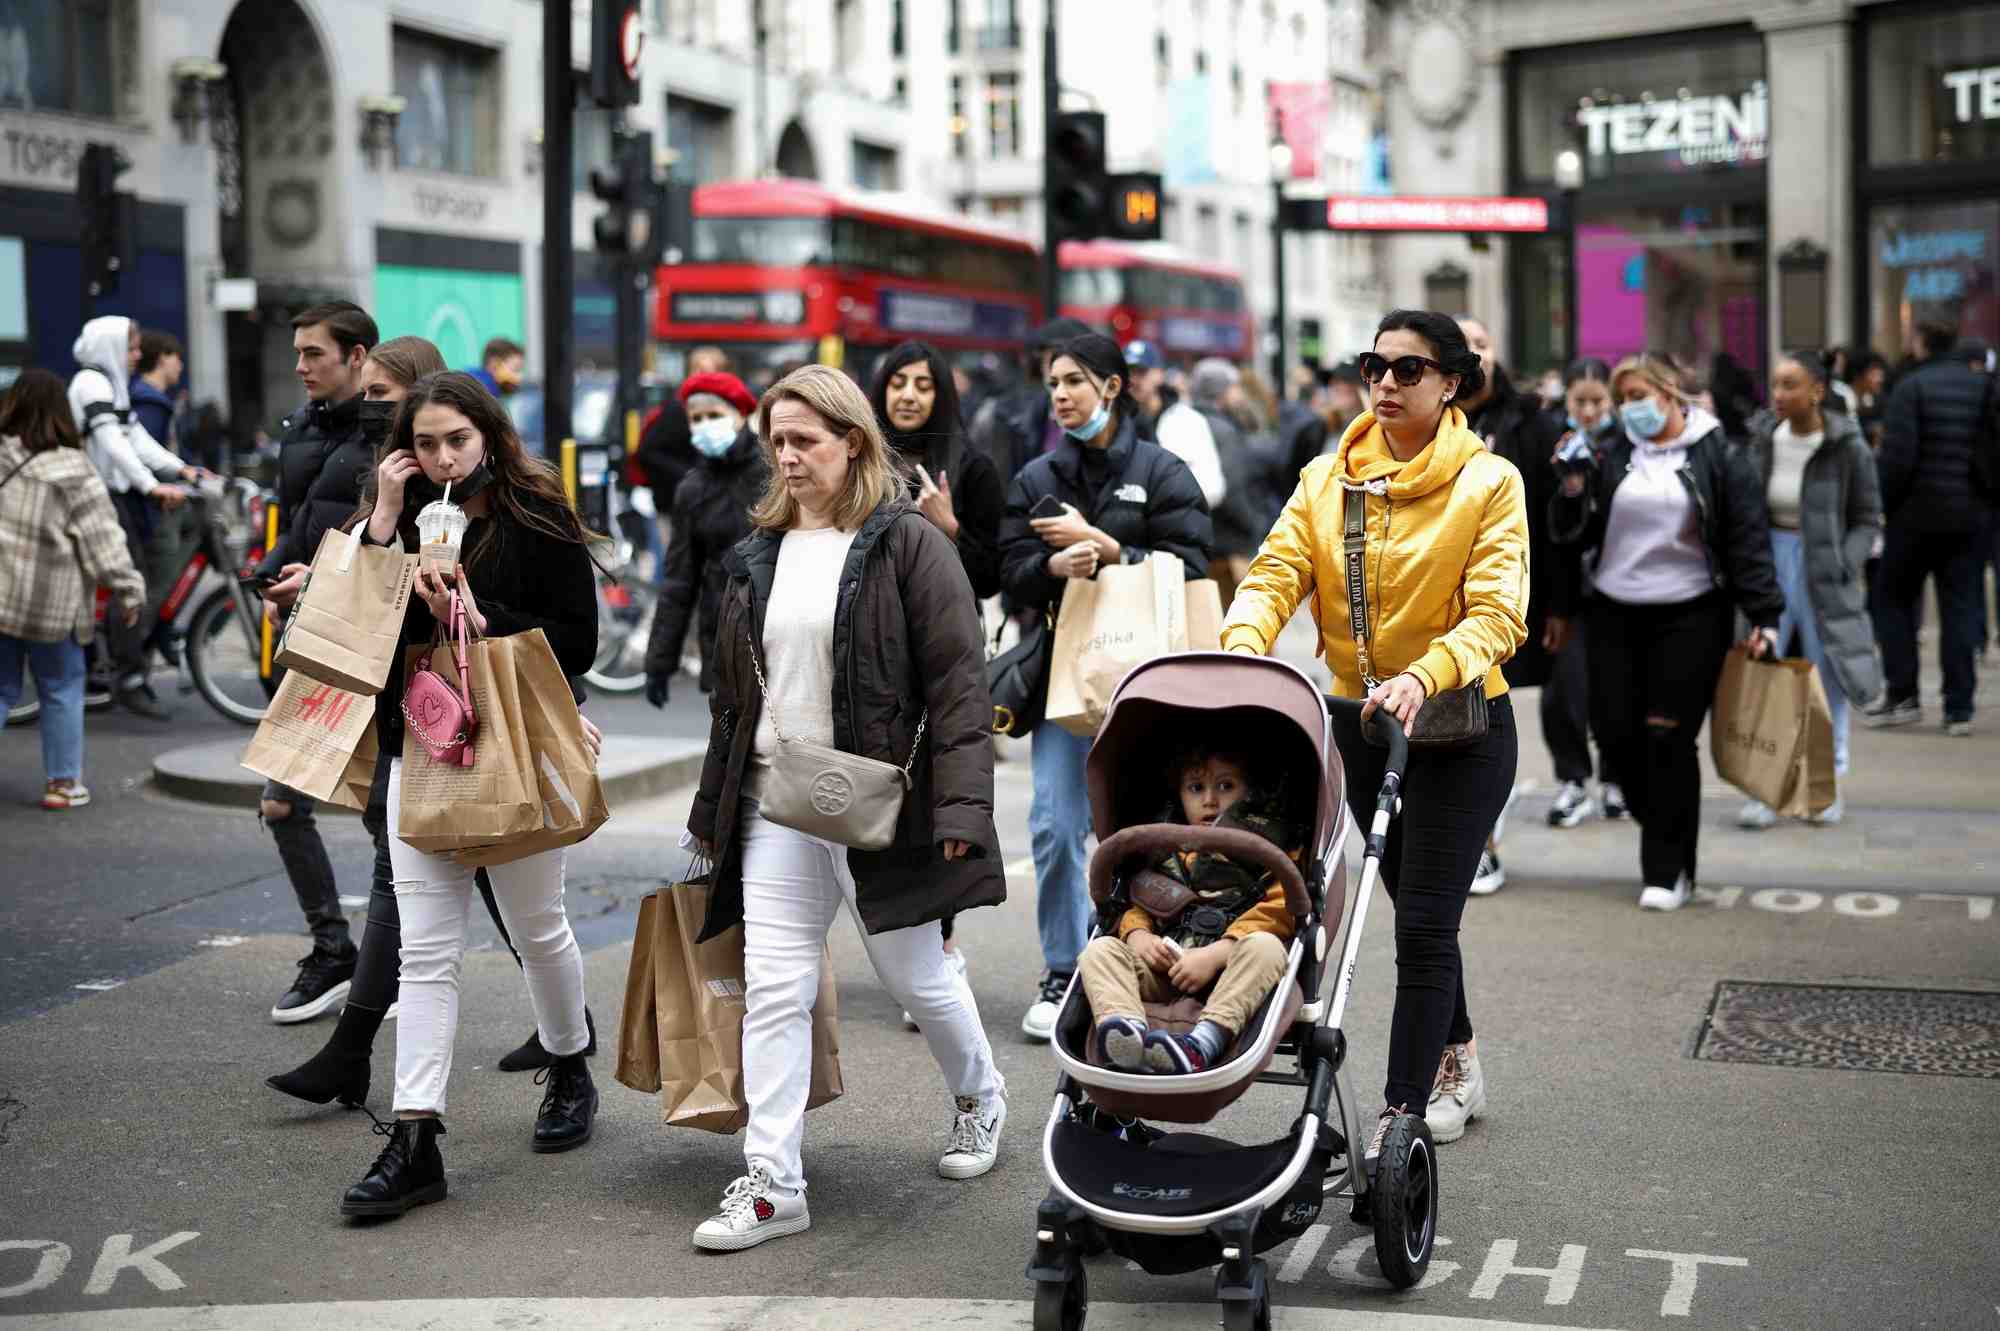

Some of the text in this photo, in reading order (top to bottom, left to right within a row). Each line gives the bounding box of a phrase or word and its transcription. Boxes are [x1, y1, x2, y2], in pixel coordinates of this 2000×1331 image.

[1576, 80, 1768, 156] TEZENI
[5, 129, 78, 179] TOPS
[394, 562, 411, 611] STARBUCKS
[1354, 605, 1365, 635] LOUIS
[1275, 1221, 1749, 1317] IGHT
